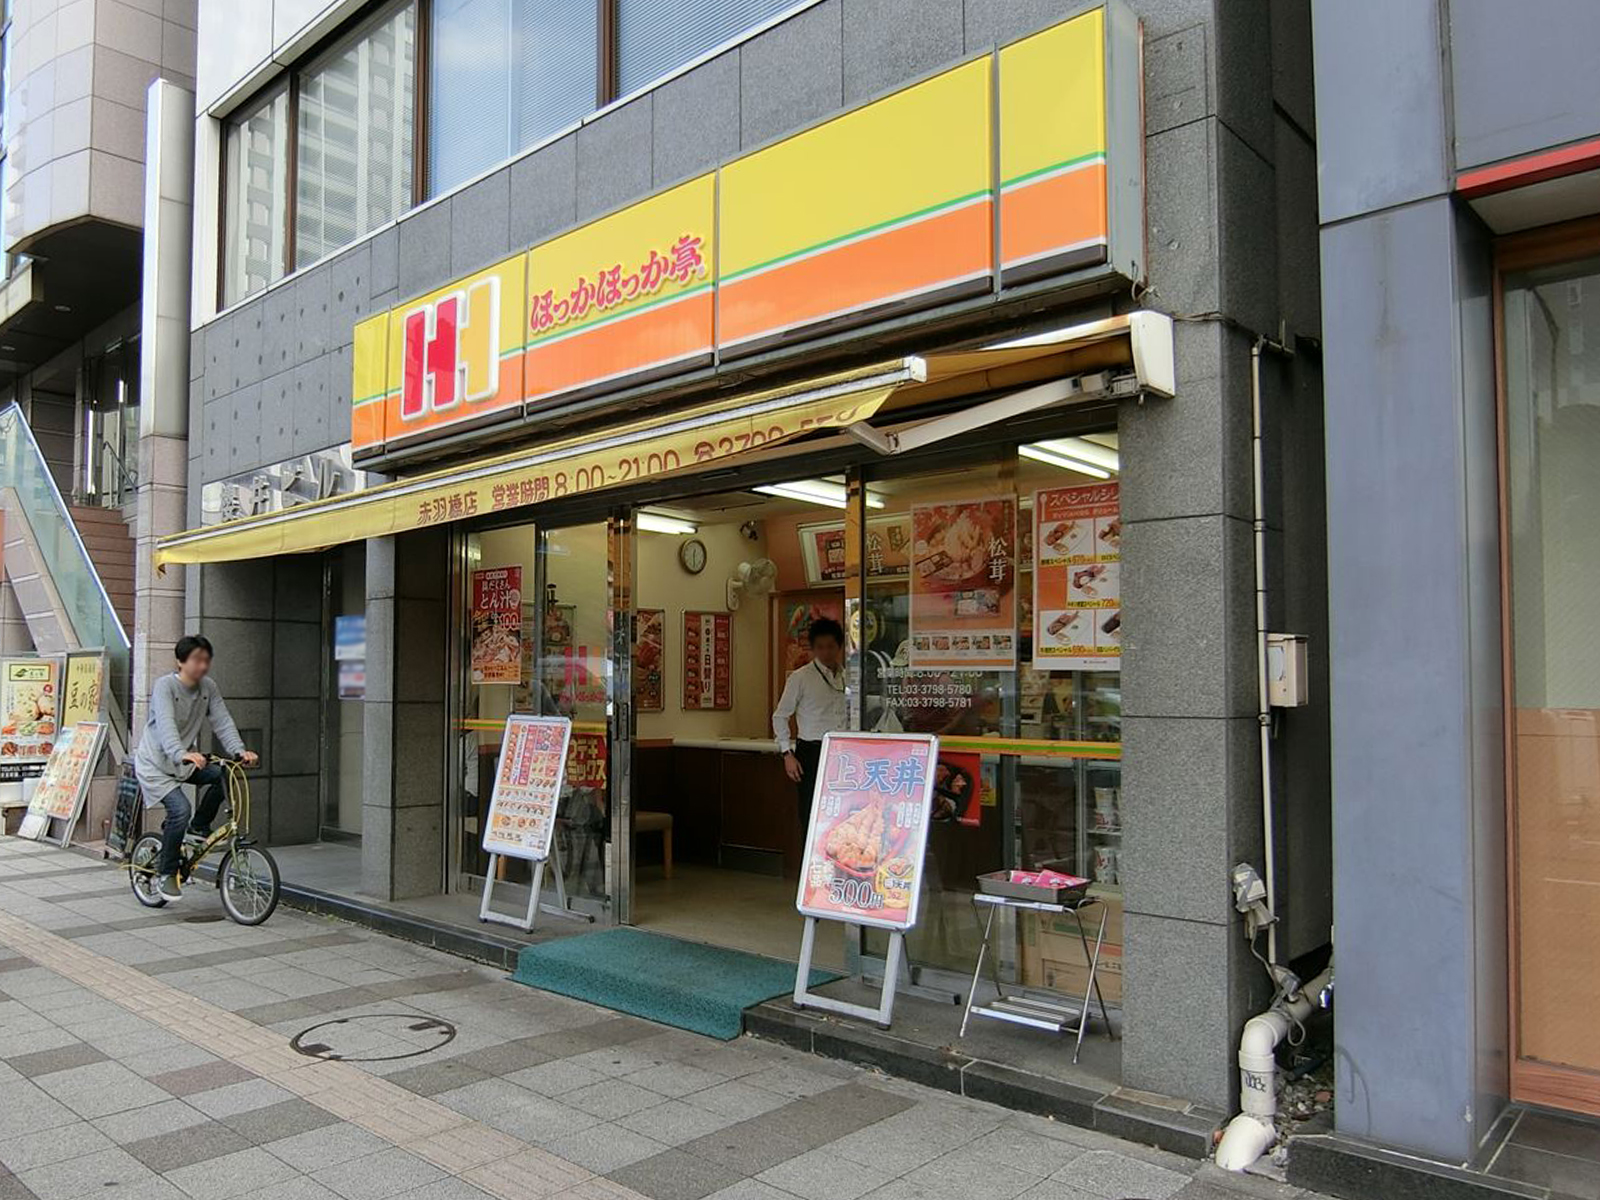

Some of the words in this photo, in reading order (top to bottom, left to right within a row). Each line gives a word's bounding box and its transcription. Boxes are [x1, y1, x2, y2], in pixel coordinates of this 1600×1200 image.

[531, 235, 702, 330] ほっかほっか亭
[417, 490, 478, 526] 赤羽橋店
[492, 476, 550, 510] 営業時間
[987, 536, 1007, 582] 松茸
[480, 589, 511, 610] とん汁
[828, 753, 925, 798] 上天丼
